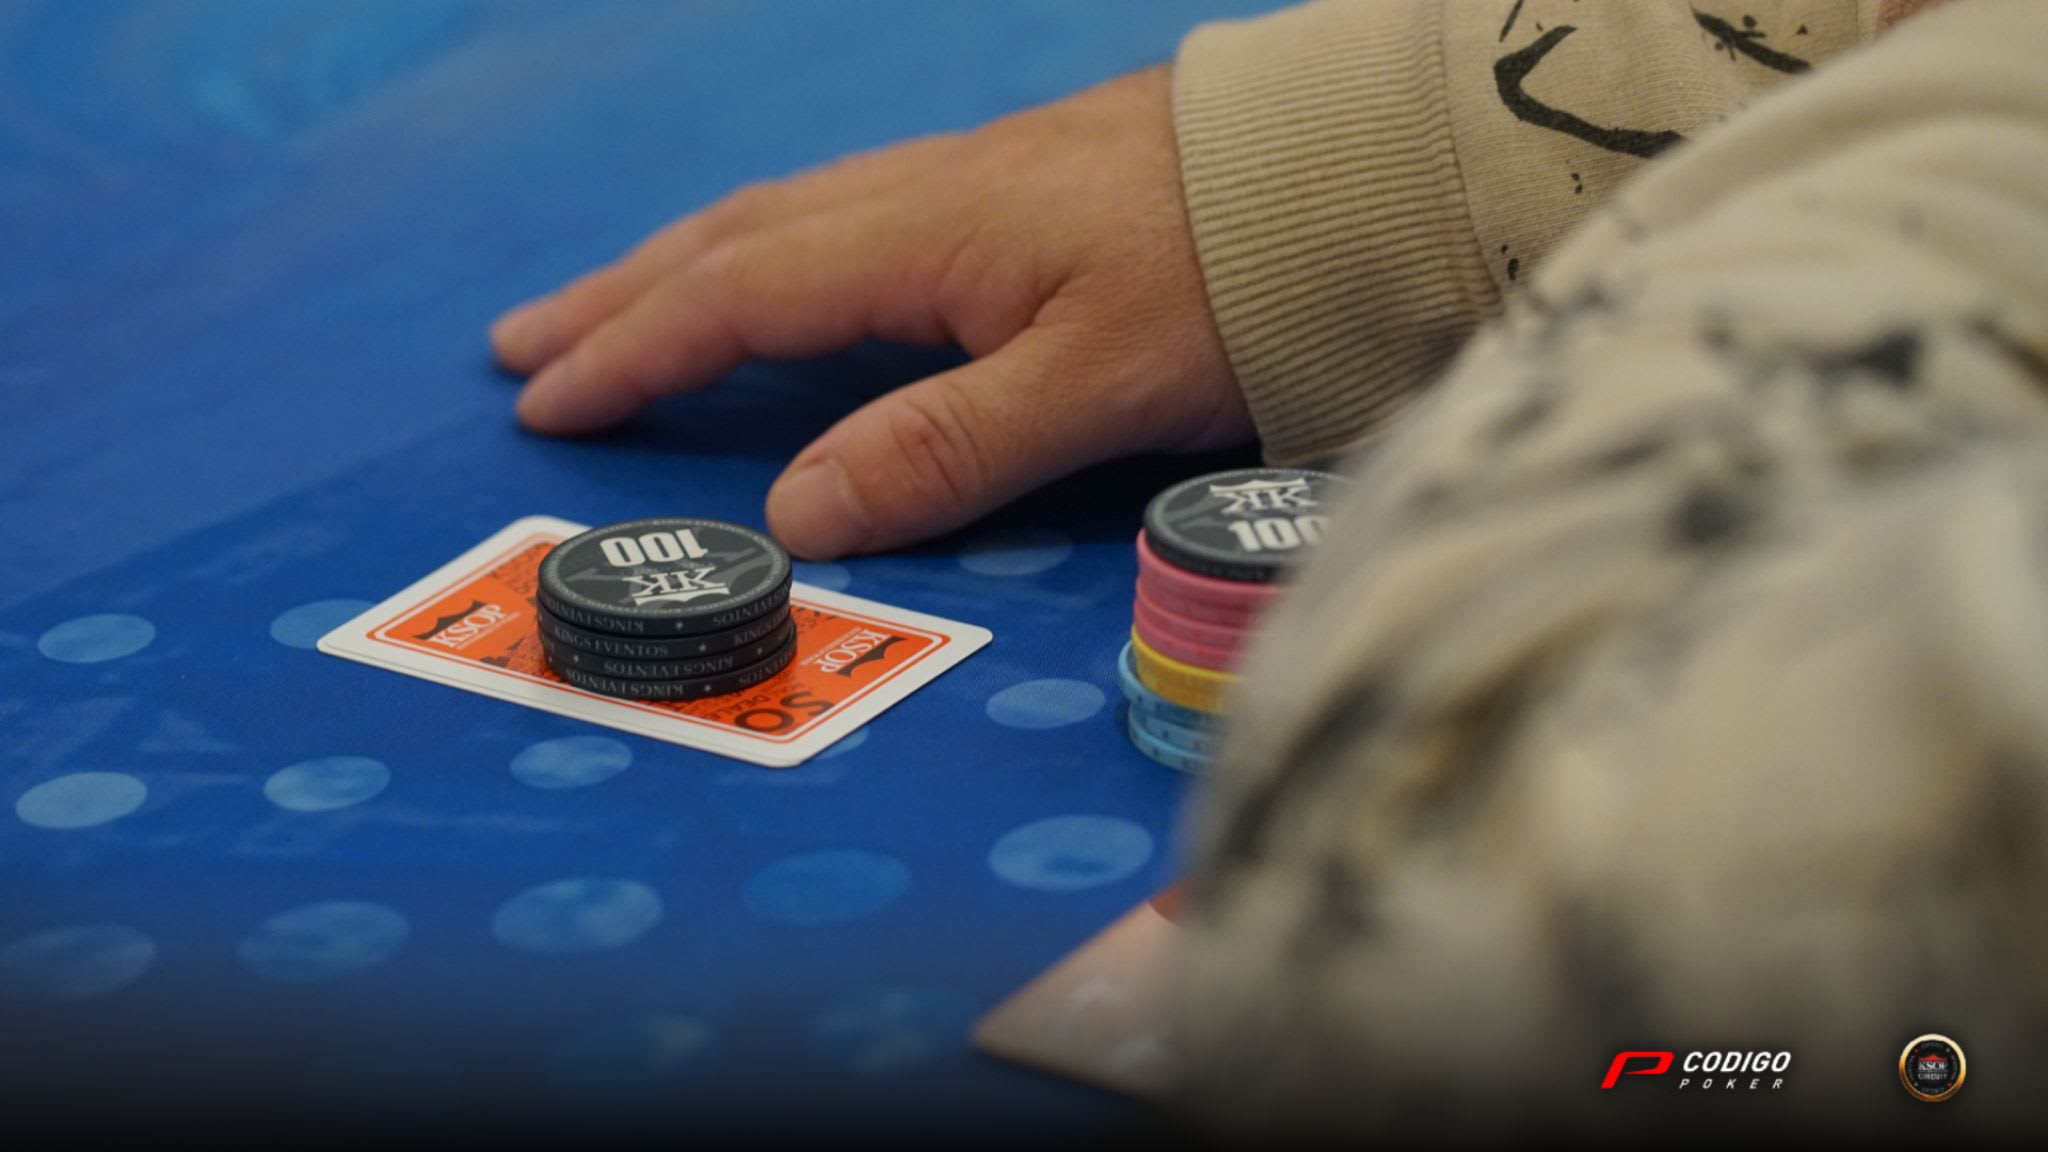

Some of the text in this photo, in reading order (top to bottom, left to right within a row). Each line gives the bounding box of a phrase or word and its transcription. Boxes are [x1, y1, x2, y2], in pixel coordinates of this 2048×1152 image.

[600, 529, 709, 567] 100
[1228, 516, 1330, 551] 100
[430, 603, 507, 648] KSOP
[594, 615, 644, 633] KINGS
[553, 625, 669, 657] KINGS EVENTOS
[815, 629, 893, 673] KSOP
[604, 656, 734, 678] KINGS EVENTOS
[630, 681, 684, 697] KINGS
